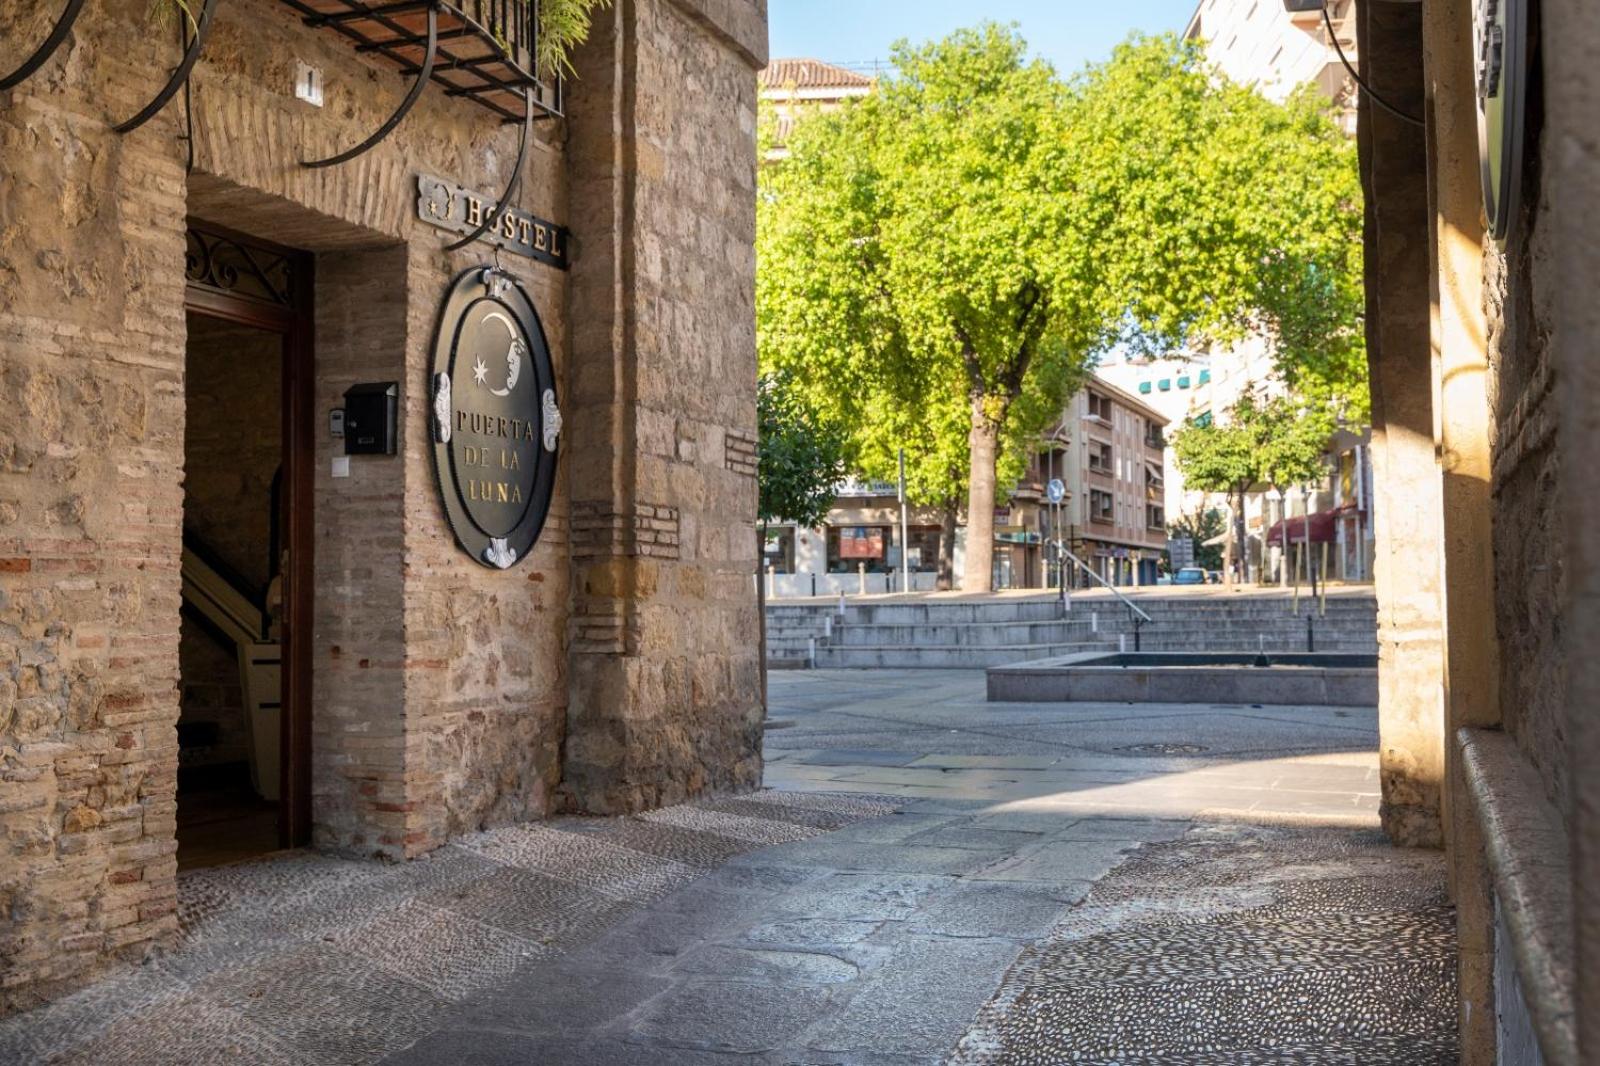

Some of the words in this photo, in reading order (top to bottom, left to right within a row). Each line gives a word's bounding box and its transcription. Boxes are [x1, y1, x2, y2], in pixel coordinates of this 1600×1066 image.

[466, 196, 560, 256] HOSTEL
[457, 410, 534, 441] PUERTA
[464, 446, 489, 467] DE
[500, 447, 520, 470] LA
[468, 480, 522, 503] LUNA
